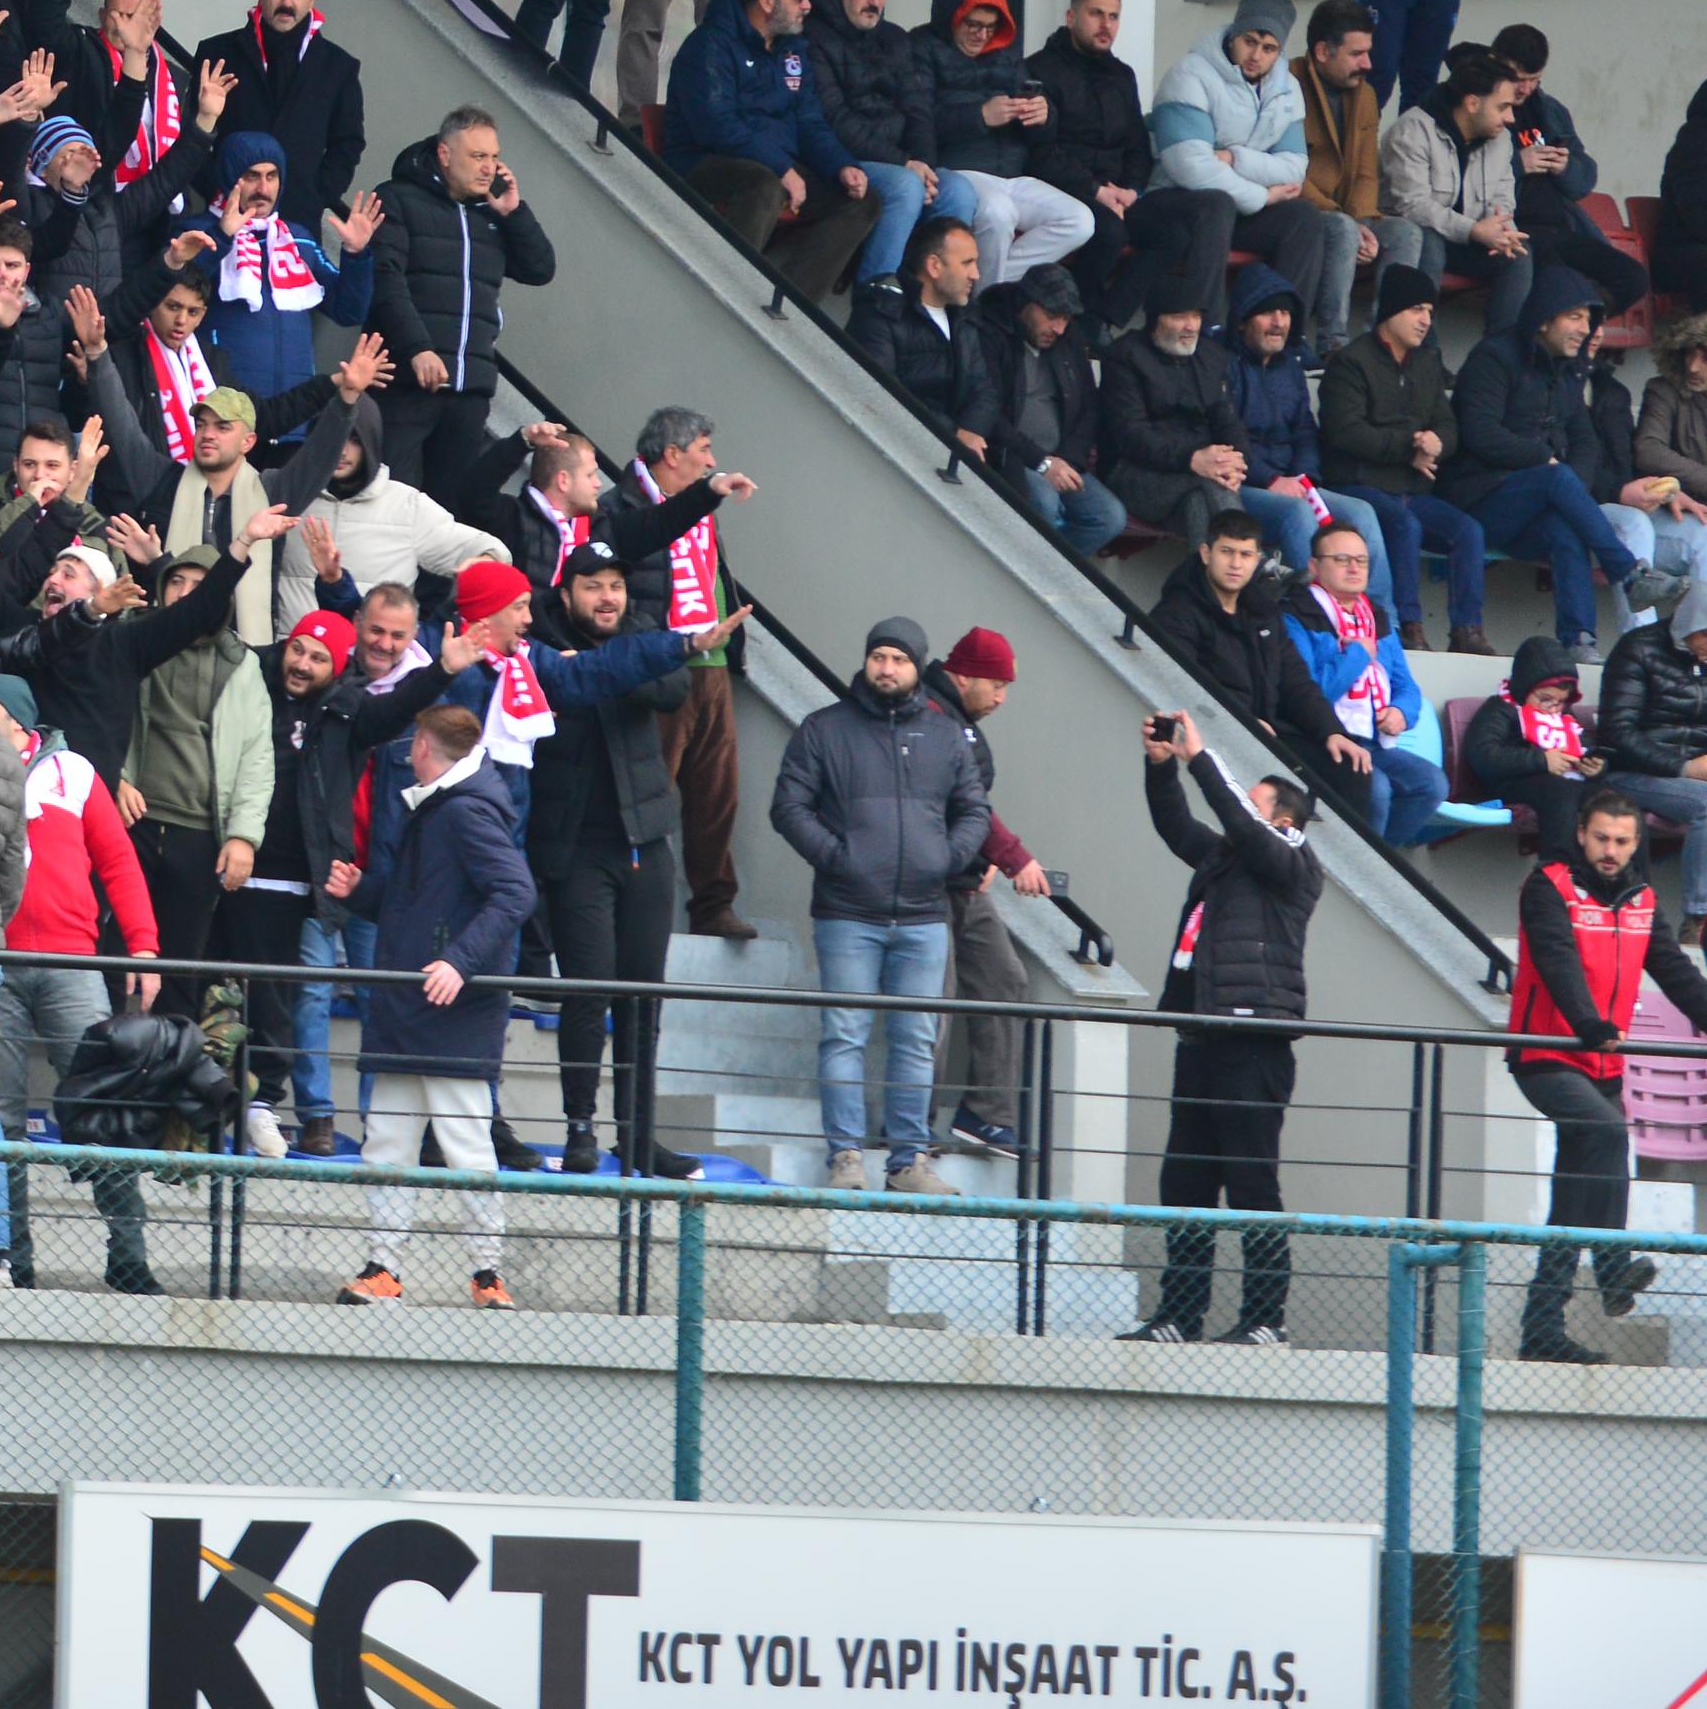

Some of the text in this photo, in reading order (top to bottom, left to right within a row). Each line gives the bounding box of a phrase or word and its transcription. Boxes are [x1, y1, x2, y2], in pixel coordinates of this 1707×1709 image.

[639, 1627, 1308, 1709] KCT YOL YAPI İNŞAAT TİC. A.Ş.
